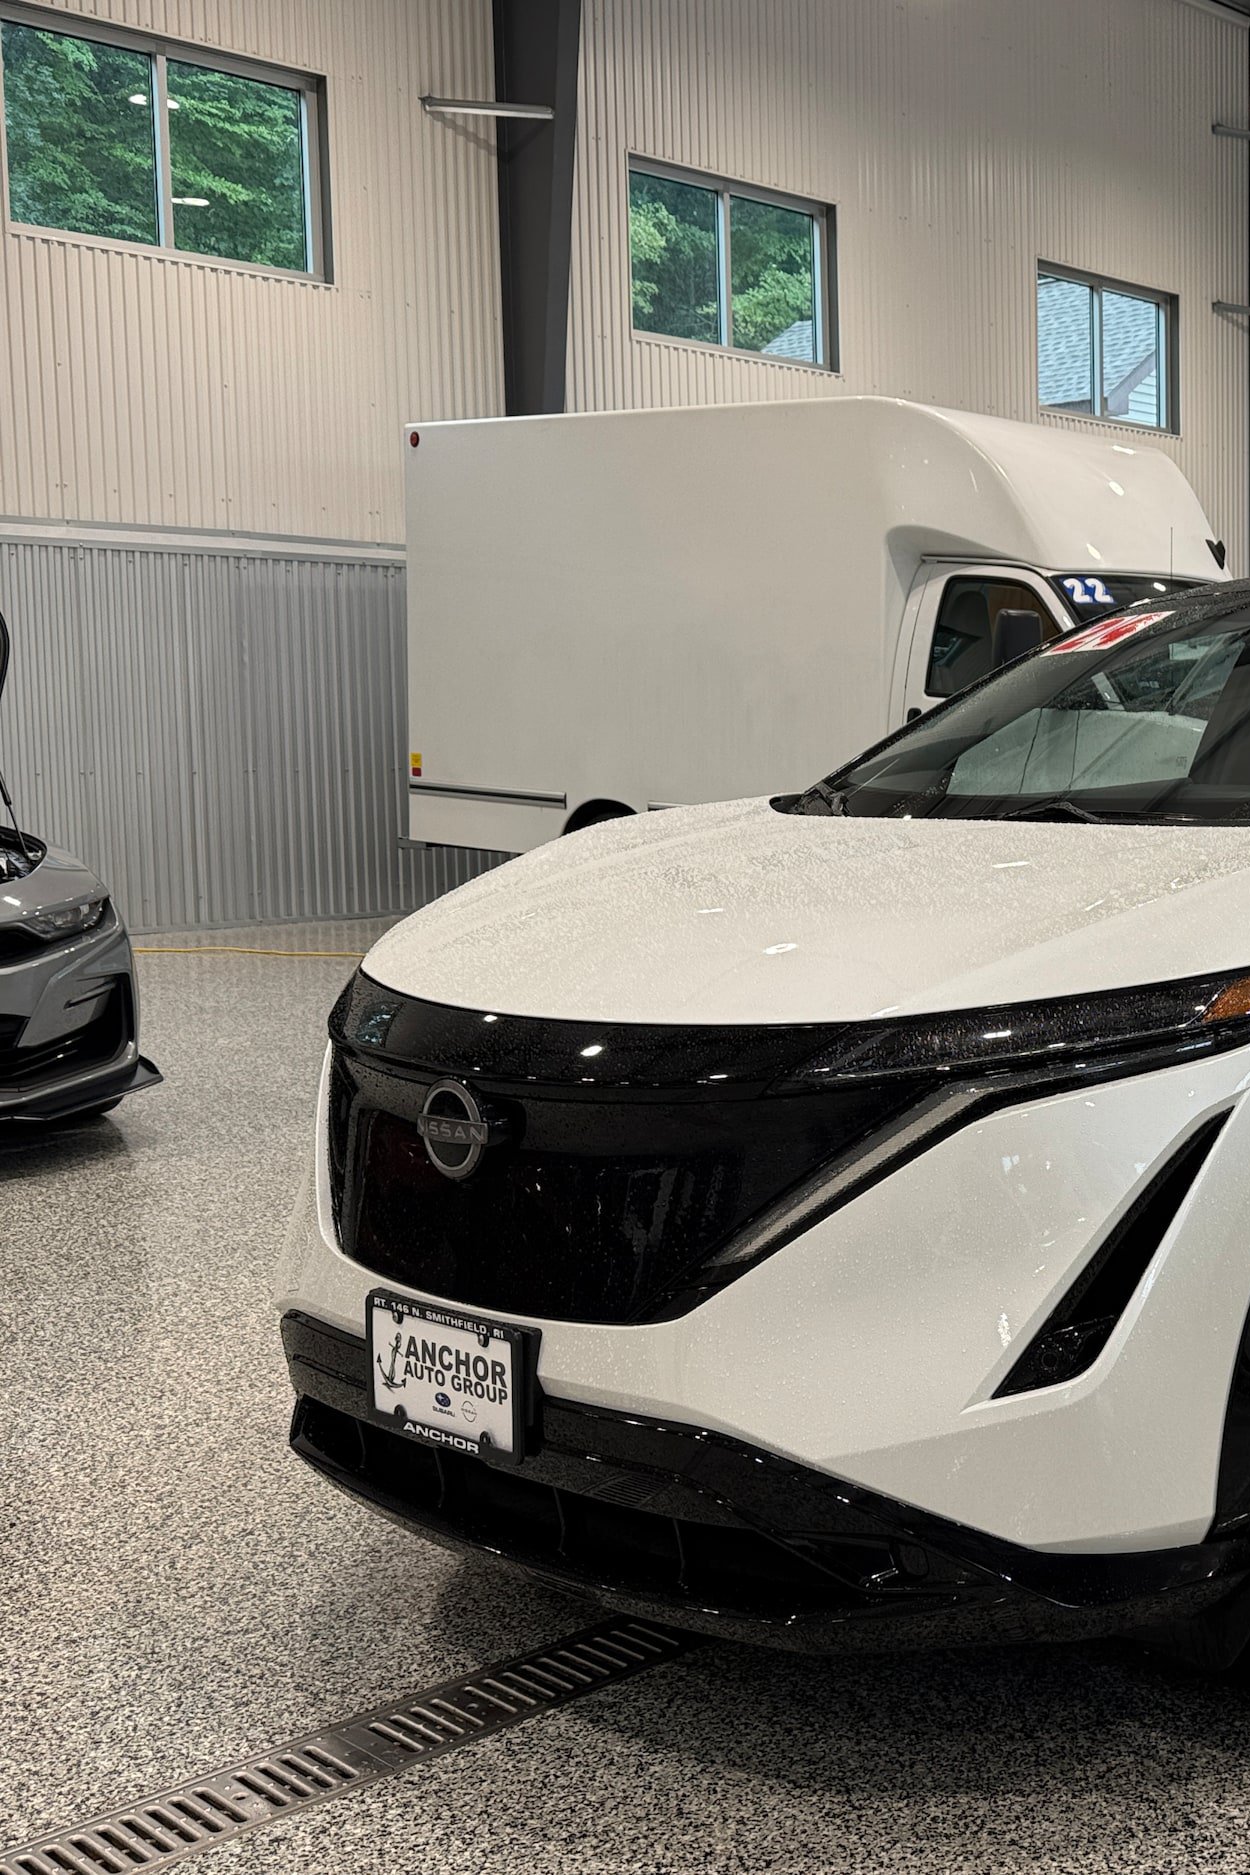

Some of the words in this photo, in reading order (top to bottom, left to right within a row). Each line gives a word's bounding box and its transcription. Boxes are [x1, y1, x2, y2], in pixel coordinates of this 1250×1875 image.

[1063, 578, 1115, 603] 22
[373, 1296, 388, 1308] RT.
[391, 1302, 410, 1314] 146
[412, 1307, 423, 1318] N.
[425, 1311, 491, 1337] SMITHFIELD,
[493, 1328, 504, 1339] RI
[403, 1360, 446, 1387] AUTO
[450, 1374, 508, 1405] GROUP
[404, 1335, 508, 1389] ANCHOR
[403, 1421, 480, 1454] ANCHOR
